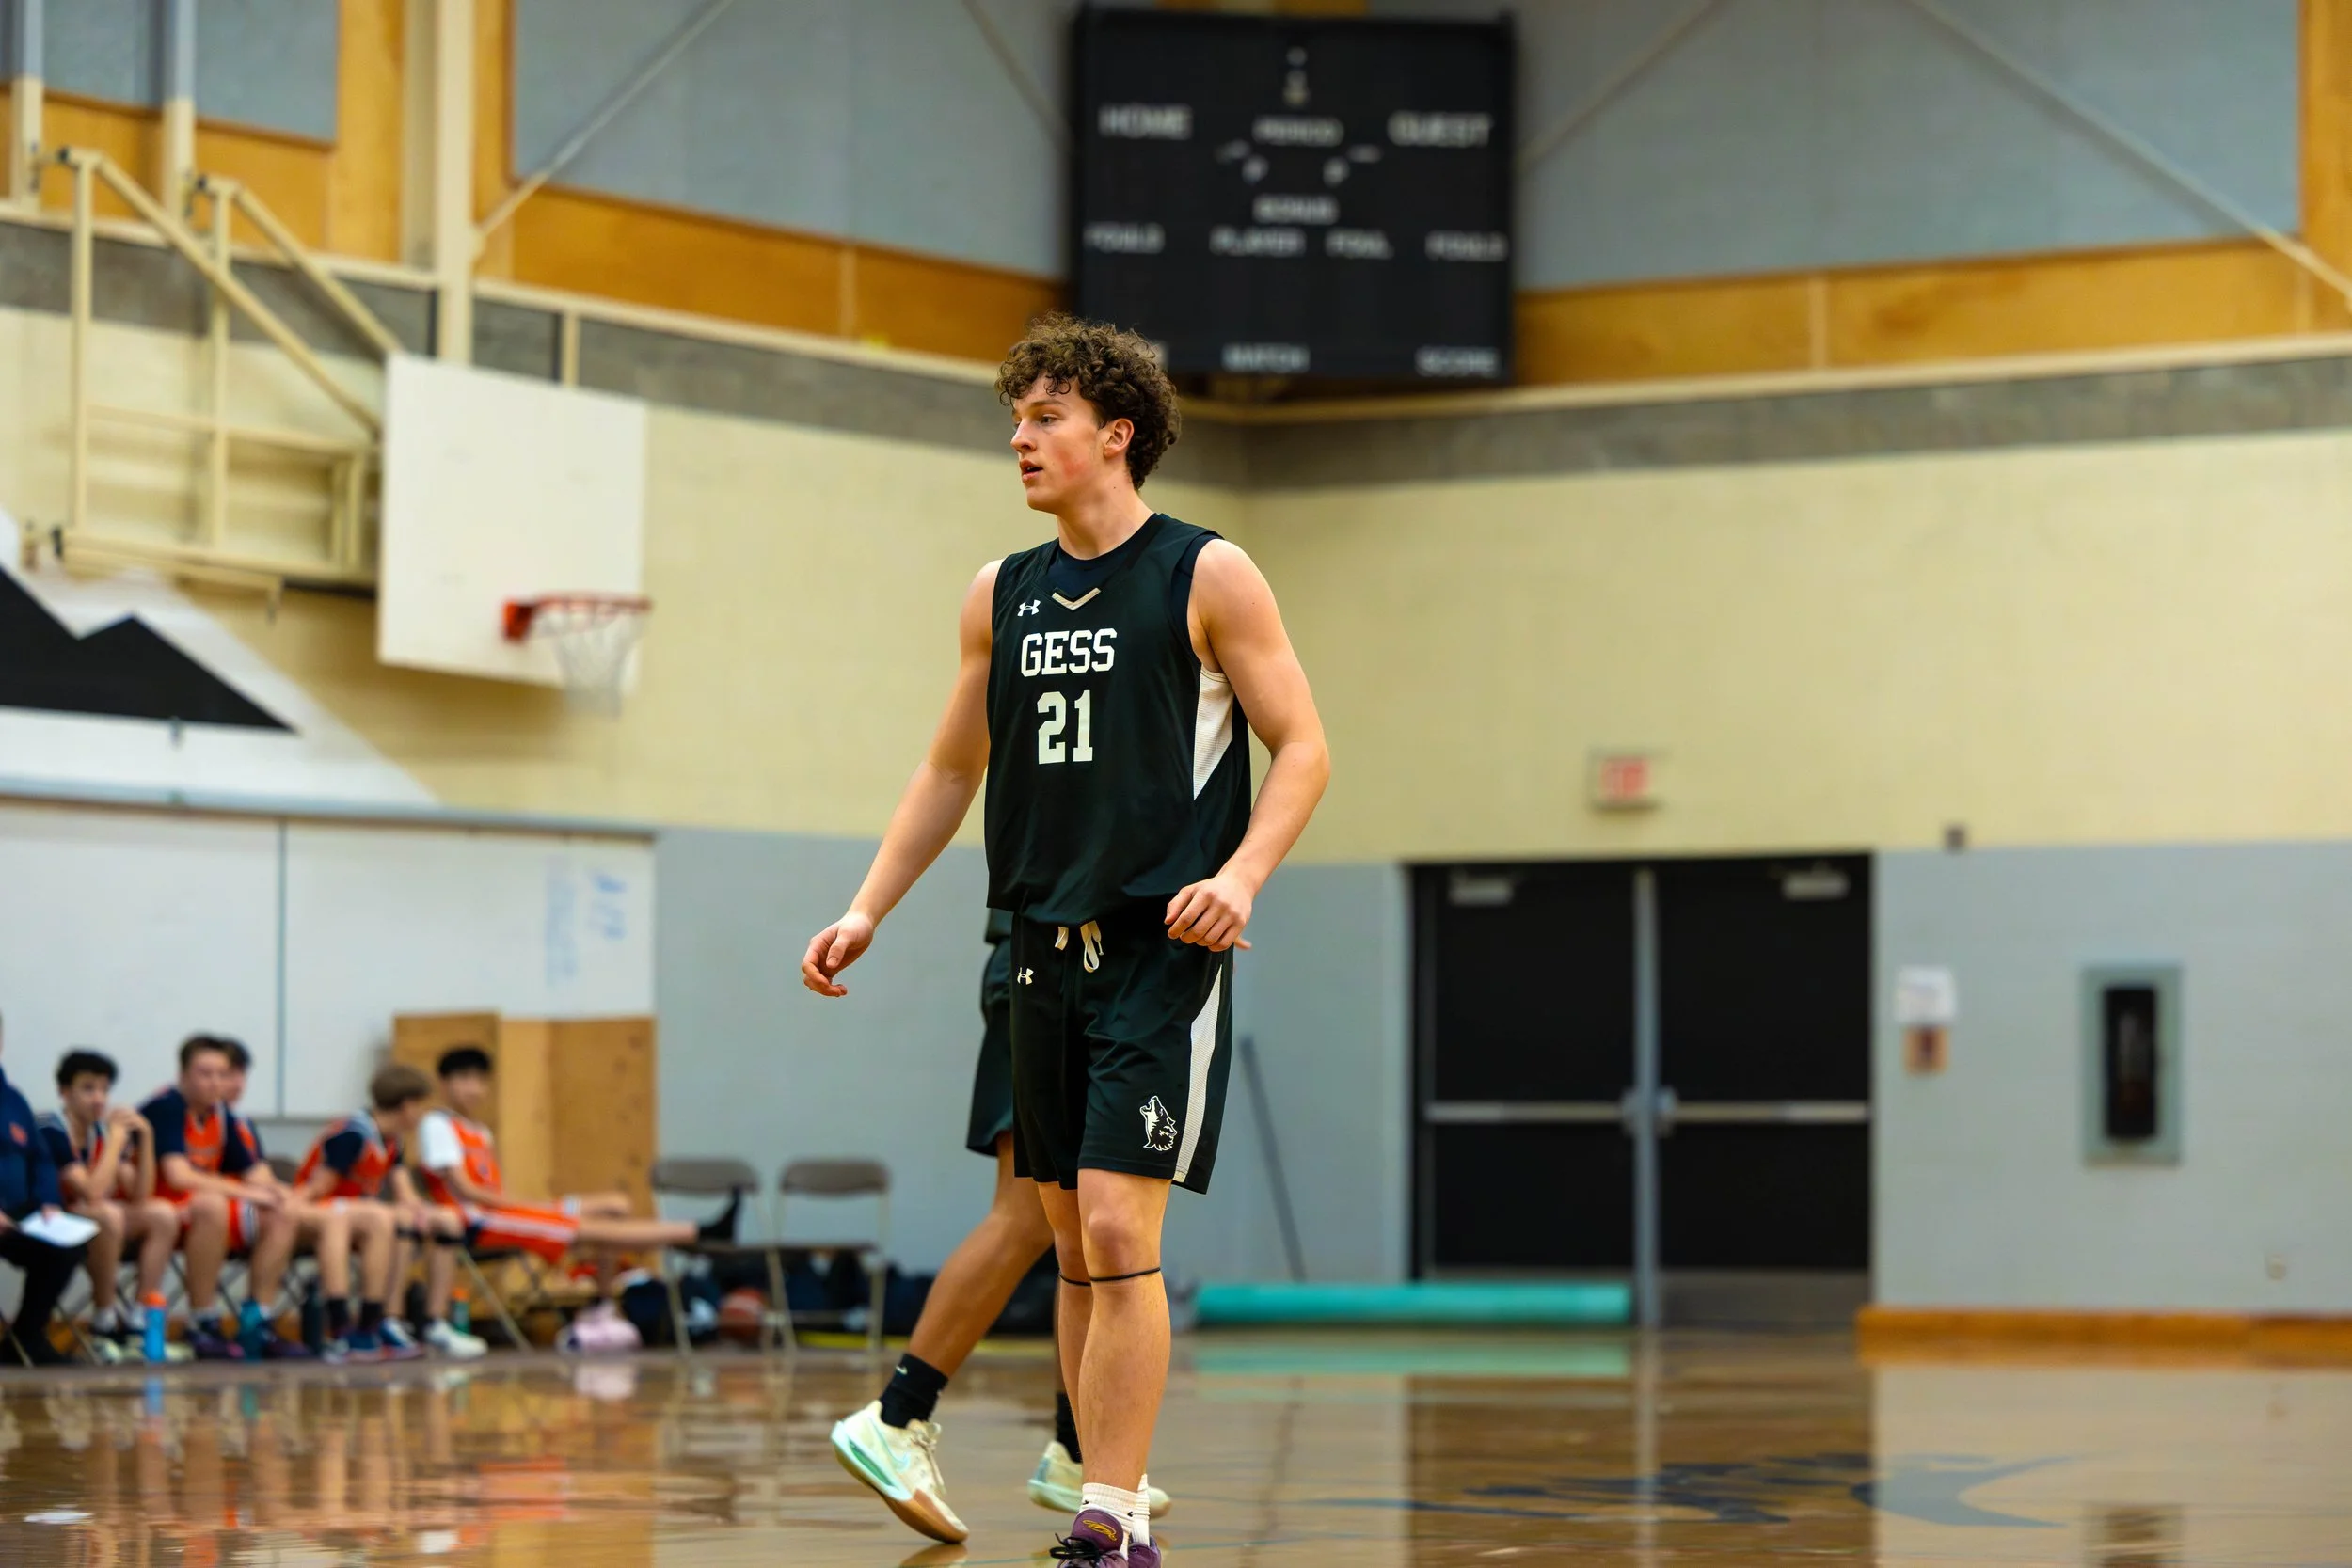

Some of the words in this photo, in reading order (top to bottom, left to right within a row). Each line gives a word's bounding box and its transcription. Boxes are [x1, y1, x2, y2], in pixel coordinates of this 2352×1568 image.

[1101, 106, 1189, 138] HOME
[1254, 119, 1342, 145] PERIOD
[1389, 113, 1489, 146] GUEST
[1212, 229, 1304, 255] PLAYER
[1327, 231, 1391, 258] FOUL
[1021, 628, 1117, 677] GESS
[1037, 689, 1093, 765] 21
